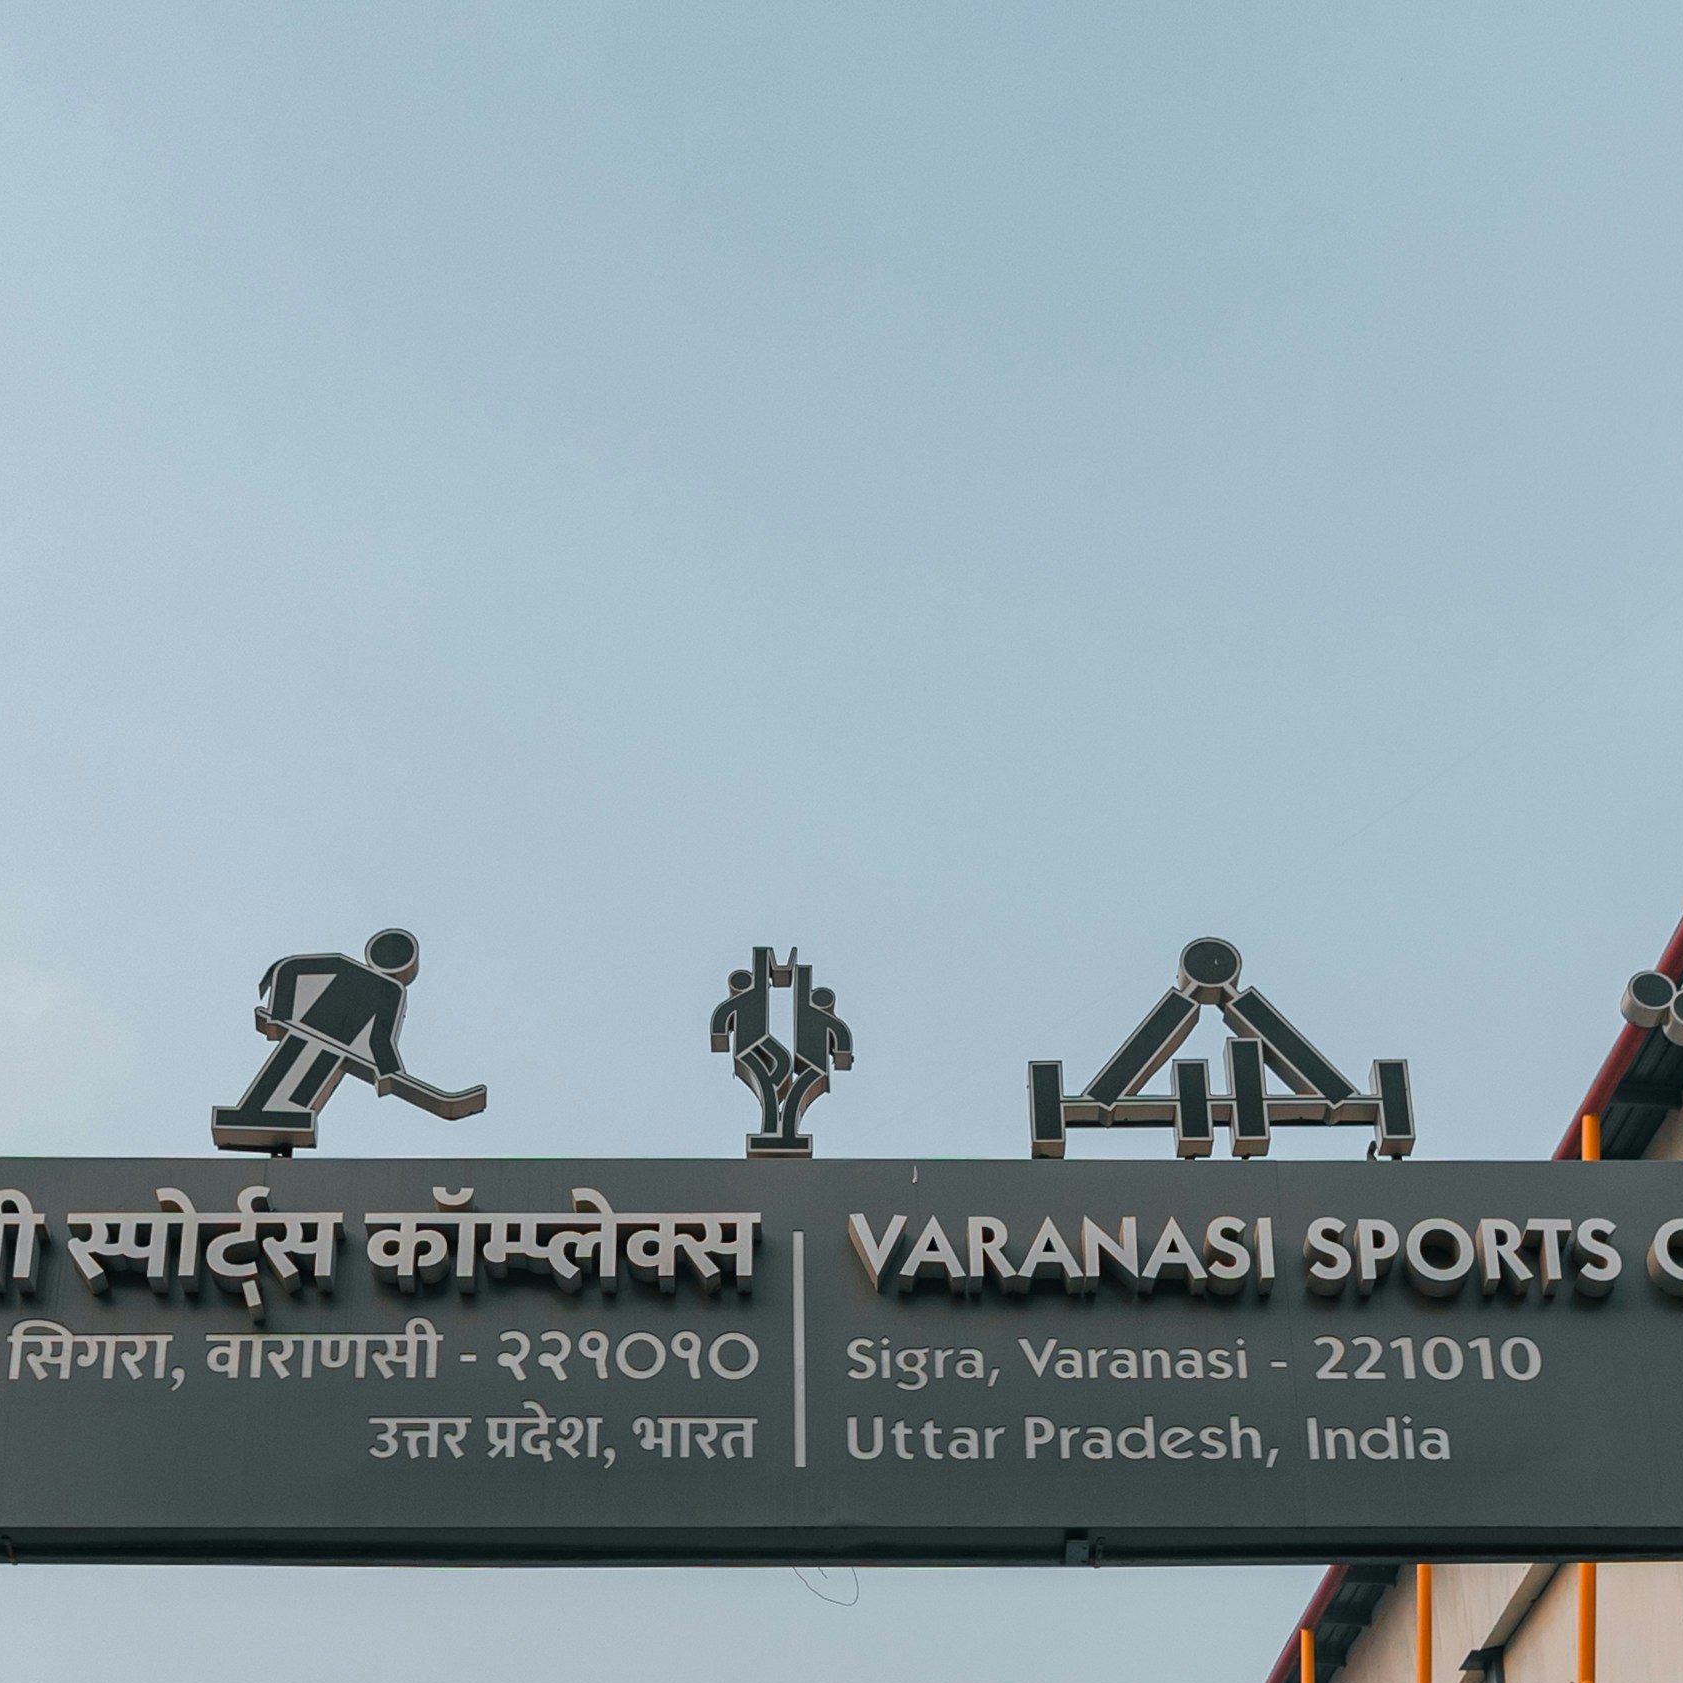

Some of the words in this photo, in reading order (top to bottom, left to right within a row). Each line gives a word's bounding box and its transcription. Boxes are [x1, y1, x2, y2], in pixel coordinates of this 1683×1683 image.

[67, 1185, 345, 1319] स्पोर्ट्स
[363, 1185, 763, 1290] कॉम्प्लेक्स
[847, 1212, 1276, 1293] VARANASI
[1304, 1215, 1623, 1296] SPORTS
[7, 1318, 186, 1392] सिगरा,
[204, 1315, 445, 1380] वाराणसी
[497, 1328, 760, 1383] २२१०१०
[846, 1336, 1001, 1391] Sigra,
[1018, 1336, 1249, 1381] Varanasi
[1313, 1334, 1544, 1383] 221010
[368, 1414, 473, 1461] उत्तर
[484, 1400, 616, 1470] प्रदेश,
[632, 1414, 759, 1460] भारत
[845, 1415, 1006, 1462] Uttar
[1023, 1414, 1281, 1469] Pradesh,
[1306, 1414, 1452, 1462] India
